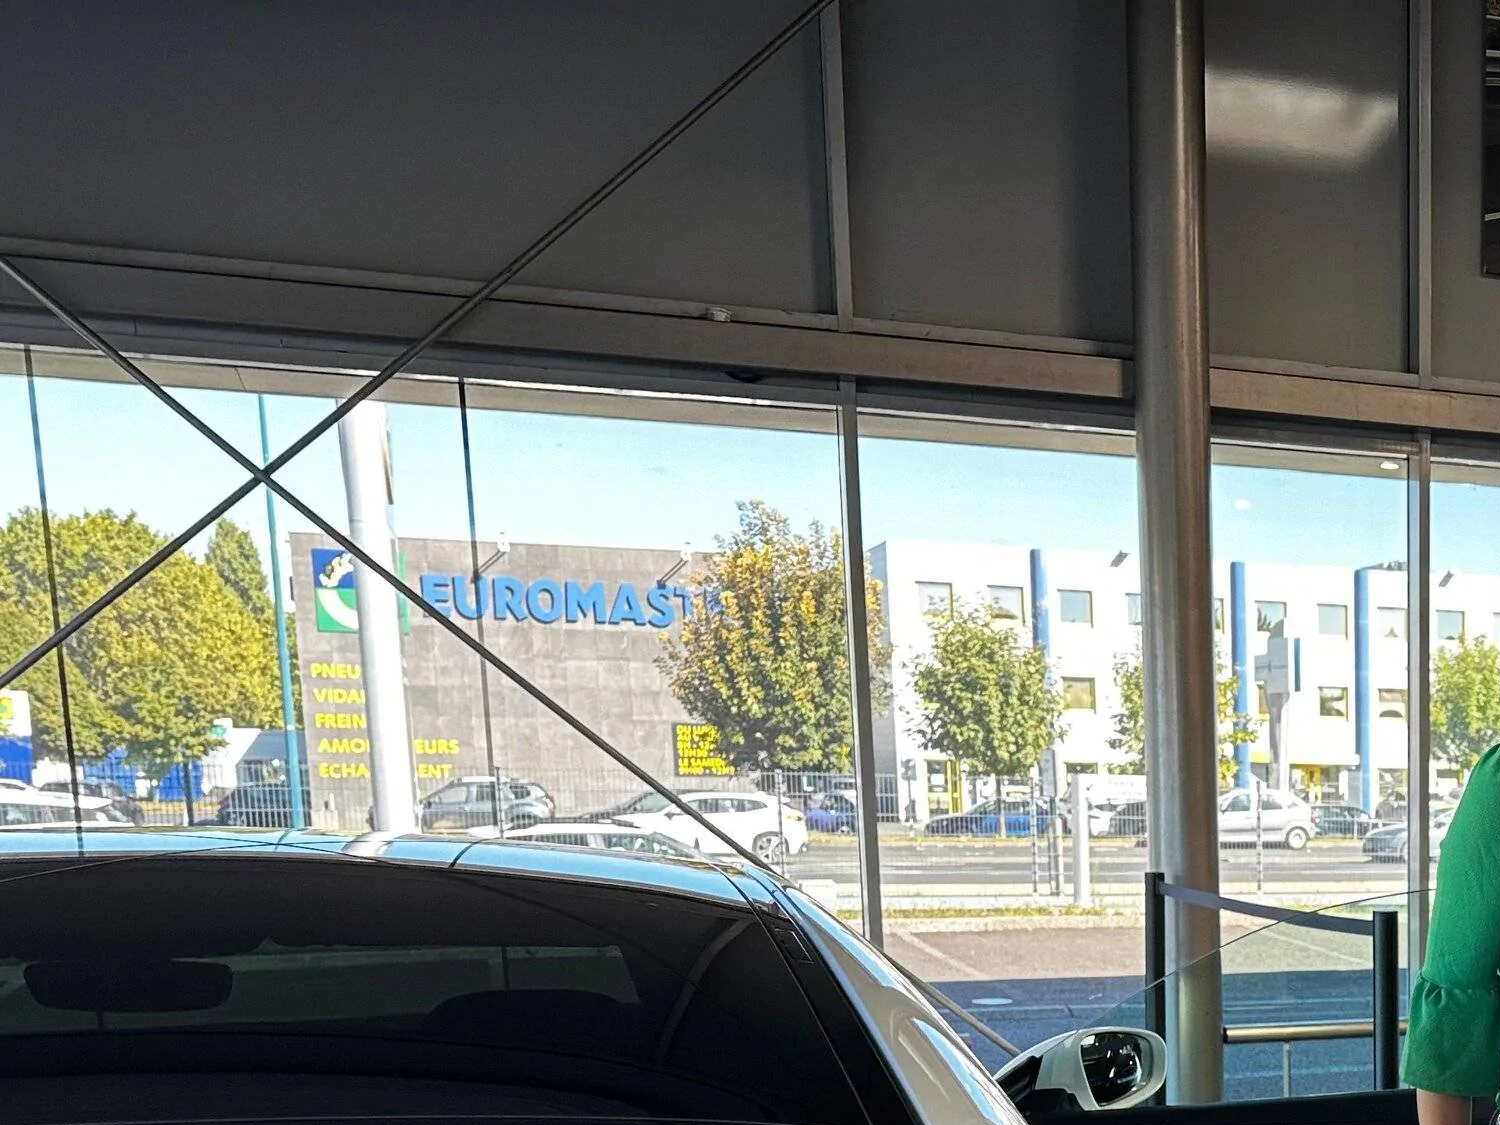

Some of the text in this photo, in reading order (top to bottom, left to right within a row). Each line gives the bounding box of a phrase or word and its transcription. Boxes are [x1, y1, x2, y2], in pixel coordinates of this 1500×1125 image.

[420, 572, 724, 628] EUROMAST
[310, 663, 361, 679] PNEU
[313, 688, 365, 704] VIDA
[315, 714, 366, 729] FREIN
